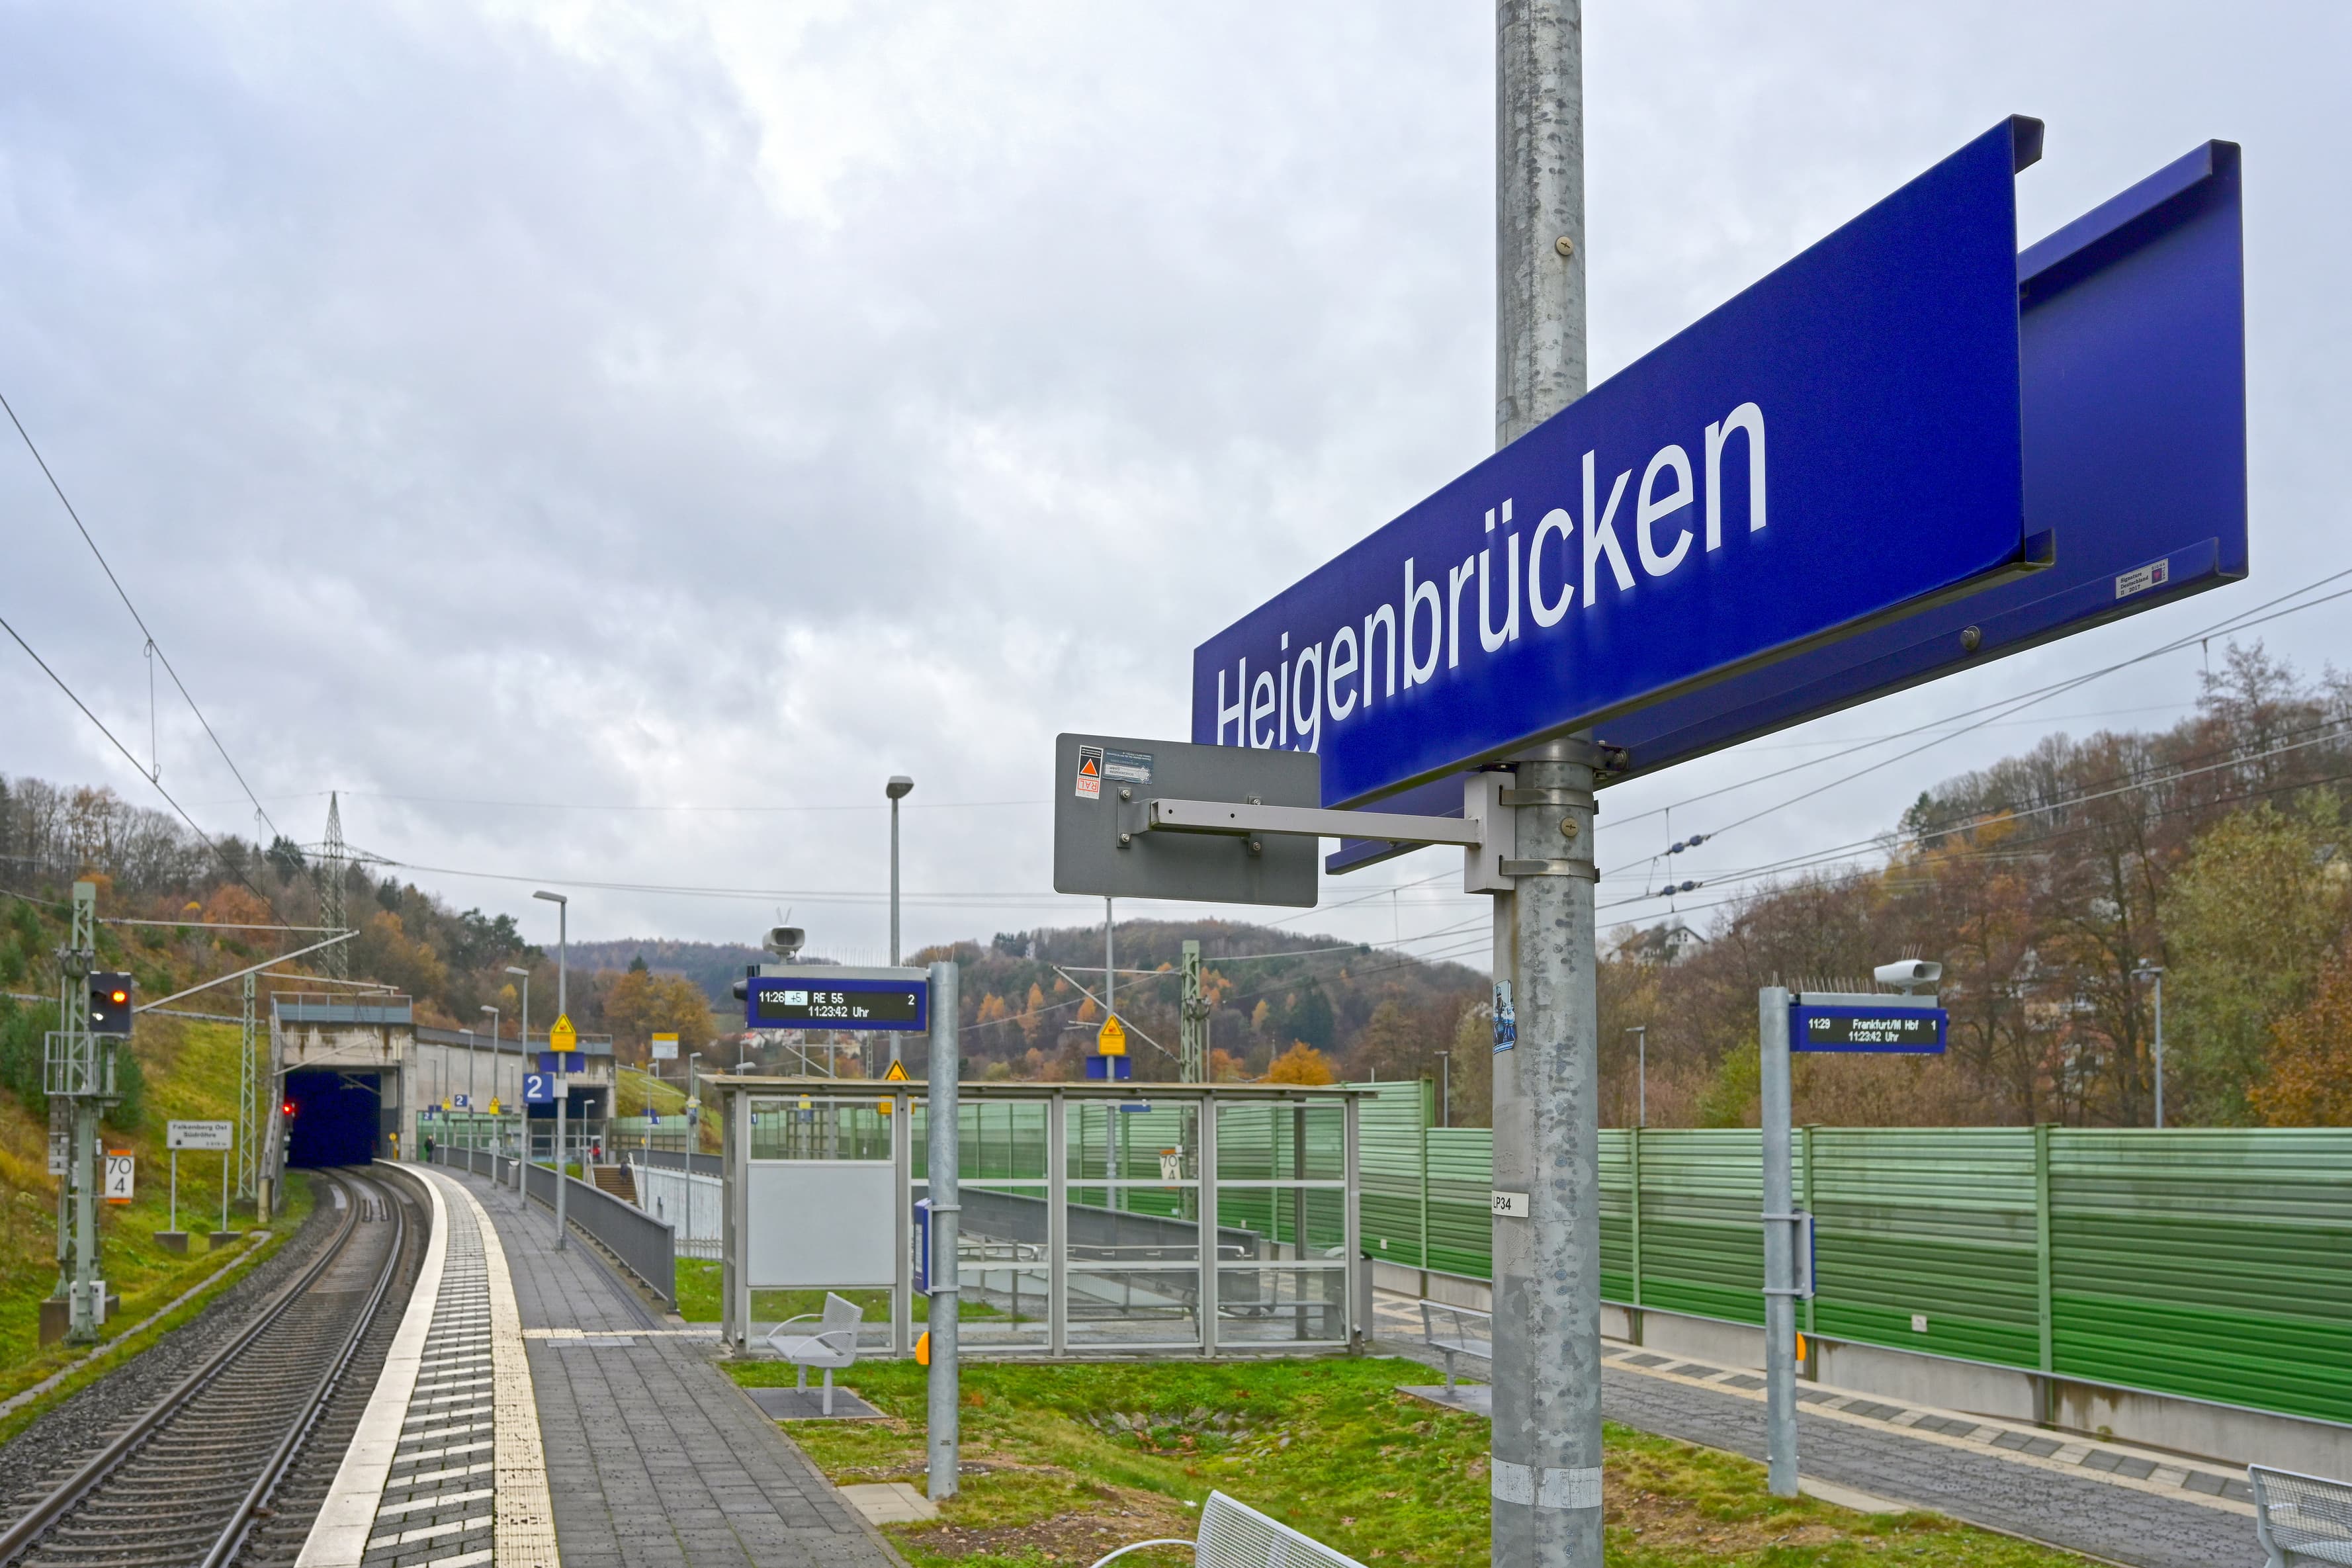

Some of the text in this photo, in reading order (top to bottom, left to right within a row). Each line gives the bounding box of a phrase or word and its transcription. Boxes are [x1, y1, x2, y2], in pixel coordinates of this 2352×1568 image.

[1217, 402, 1766, 753] Heigenbrücken
[2120, 572, 2142, 583] Signature
[2120, 575, 2149, 589] Deutschland
[1079, 780, 1097, 791] RAL
[759, 992, 915, 1005] 11:26 +5 RE 55 2
[808, 1006, 869, 1018] 11:23:42 Uhr
[1852, 1019, 1901, 1030] Frankfurt/M
[1905, 1020, 1919, 1030] Hbf
[1931, 1020, 1936, 1031] 1
[1849, 1031, 1899, 1042] 11:23:42 Uhr
[527, 1075, 543, 1098] 2
[456, 1095, 463, 1106] 2
[109, 1158, 131, 1174] 70
[1161, 1155, 1177, 1168] 70
[114, 1177, 125, 1194] 4
[1493, 1196, 1511, 1210] LP34
